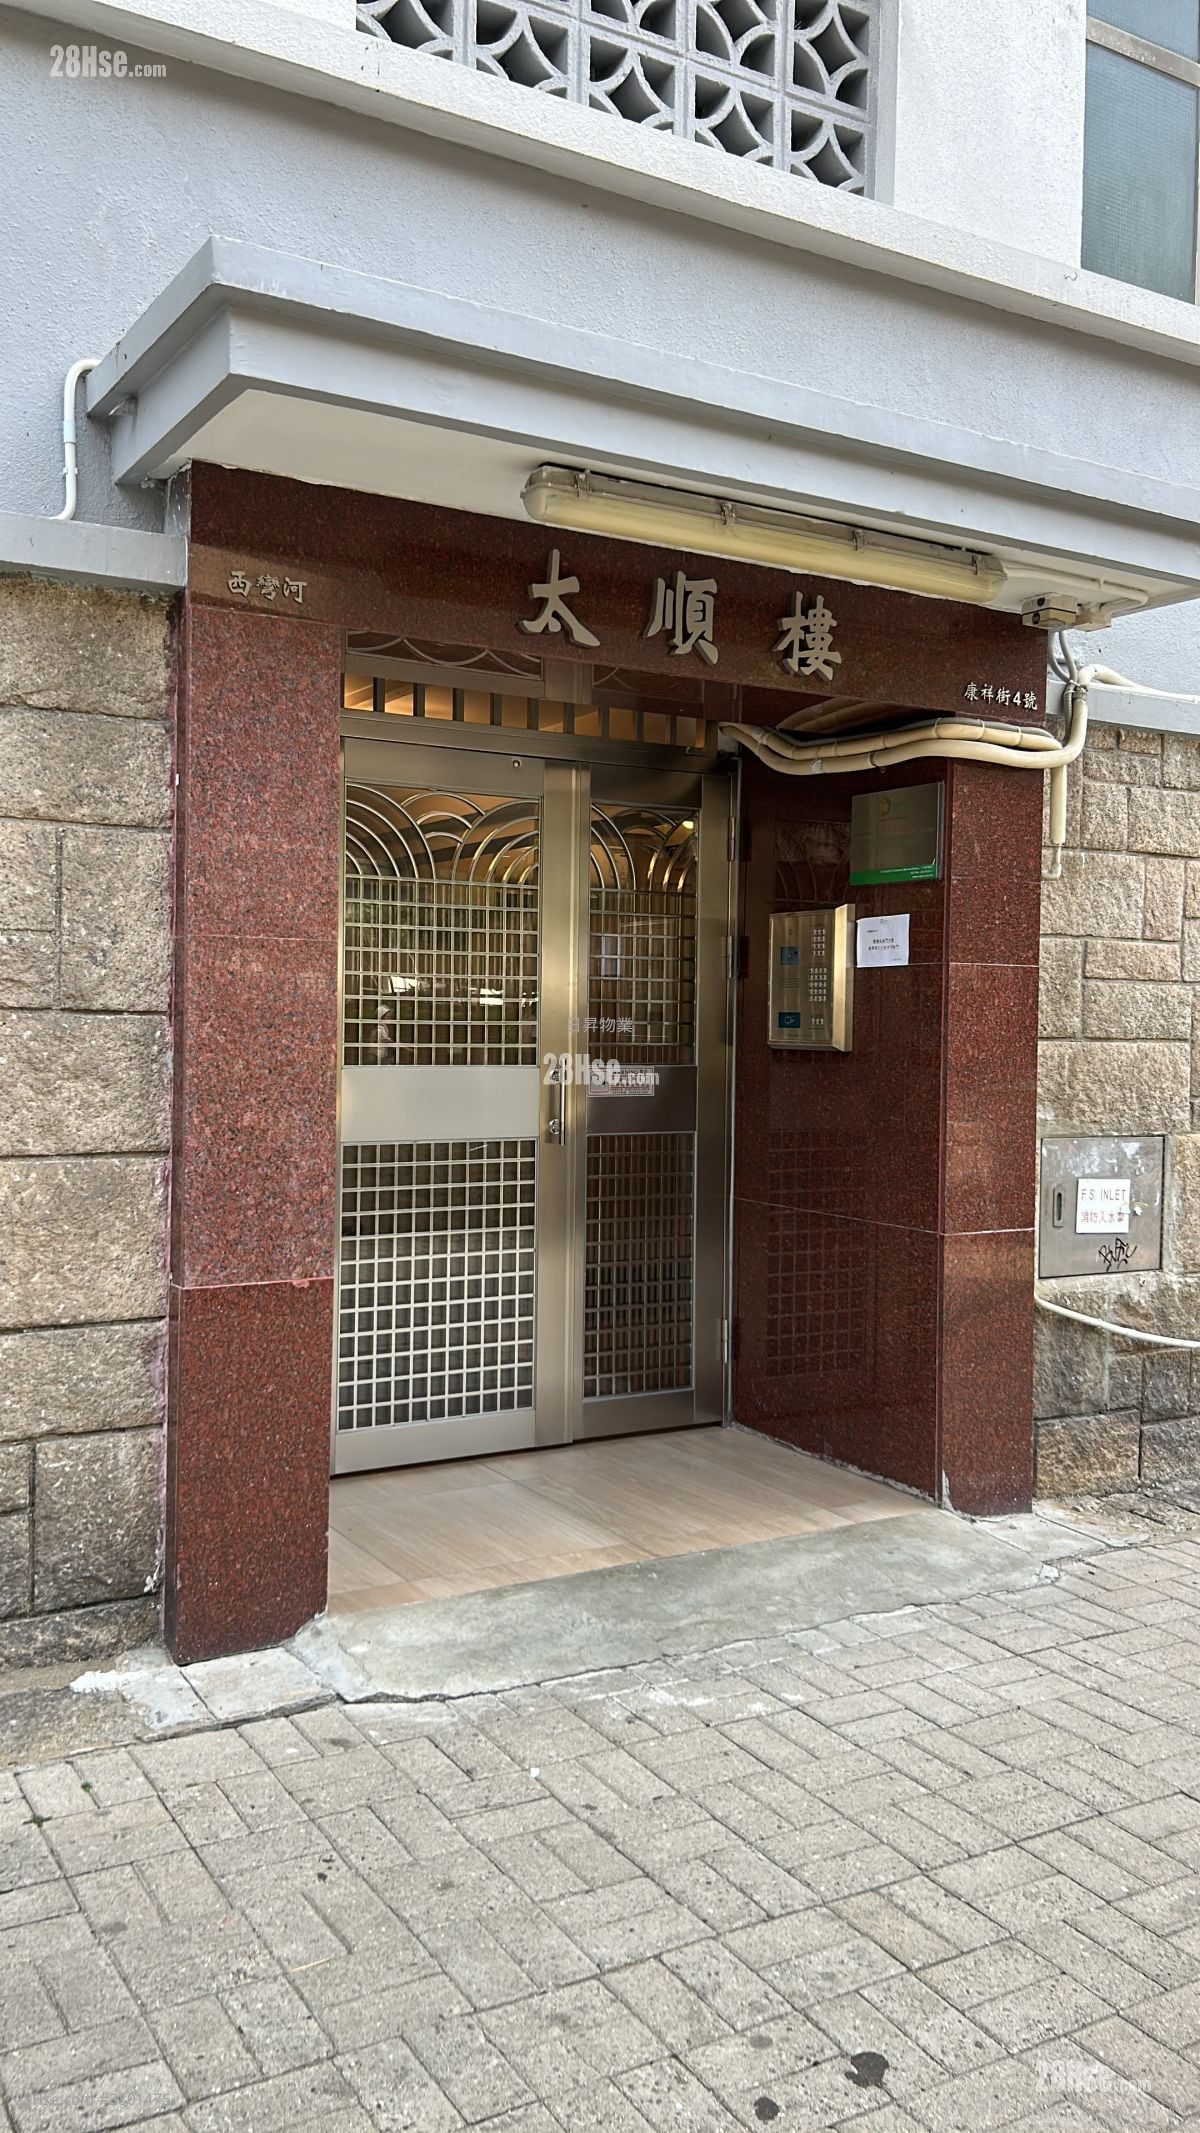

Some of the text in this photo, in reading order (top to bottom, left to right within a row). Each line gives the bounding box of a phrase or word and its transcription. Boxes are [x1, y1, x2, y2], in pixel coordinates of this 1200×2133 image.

[519, 549, 842, 682] 太順樓
[964, 682, 1038, 710] 康祥街4號
[1100, 1188, 1126, 1201] INLET
